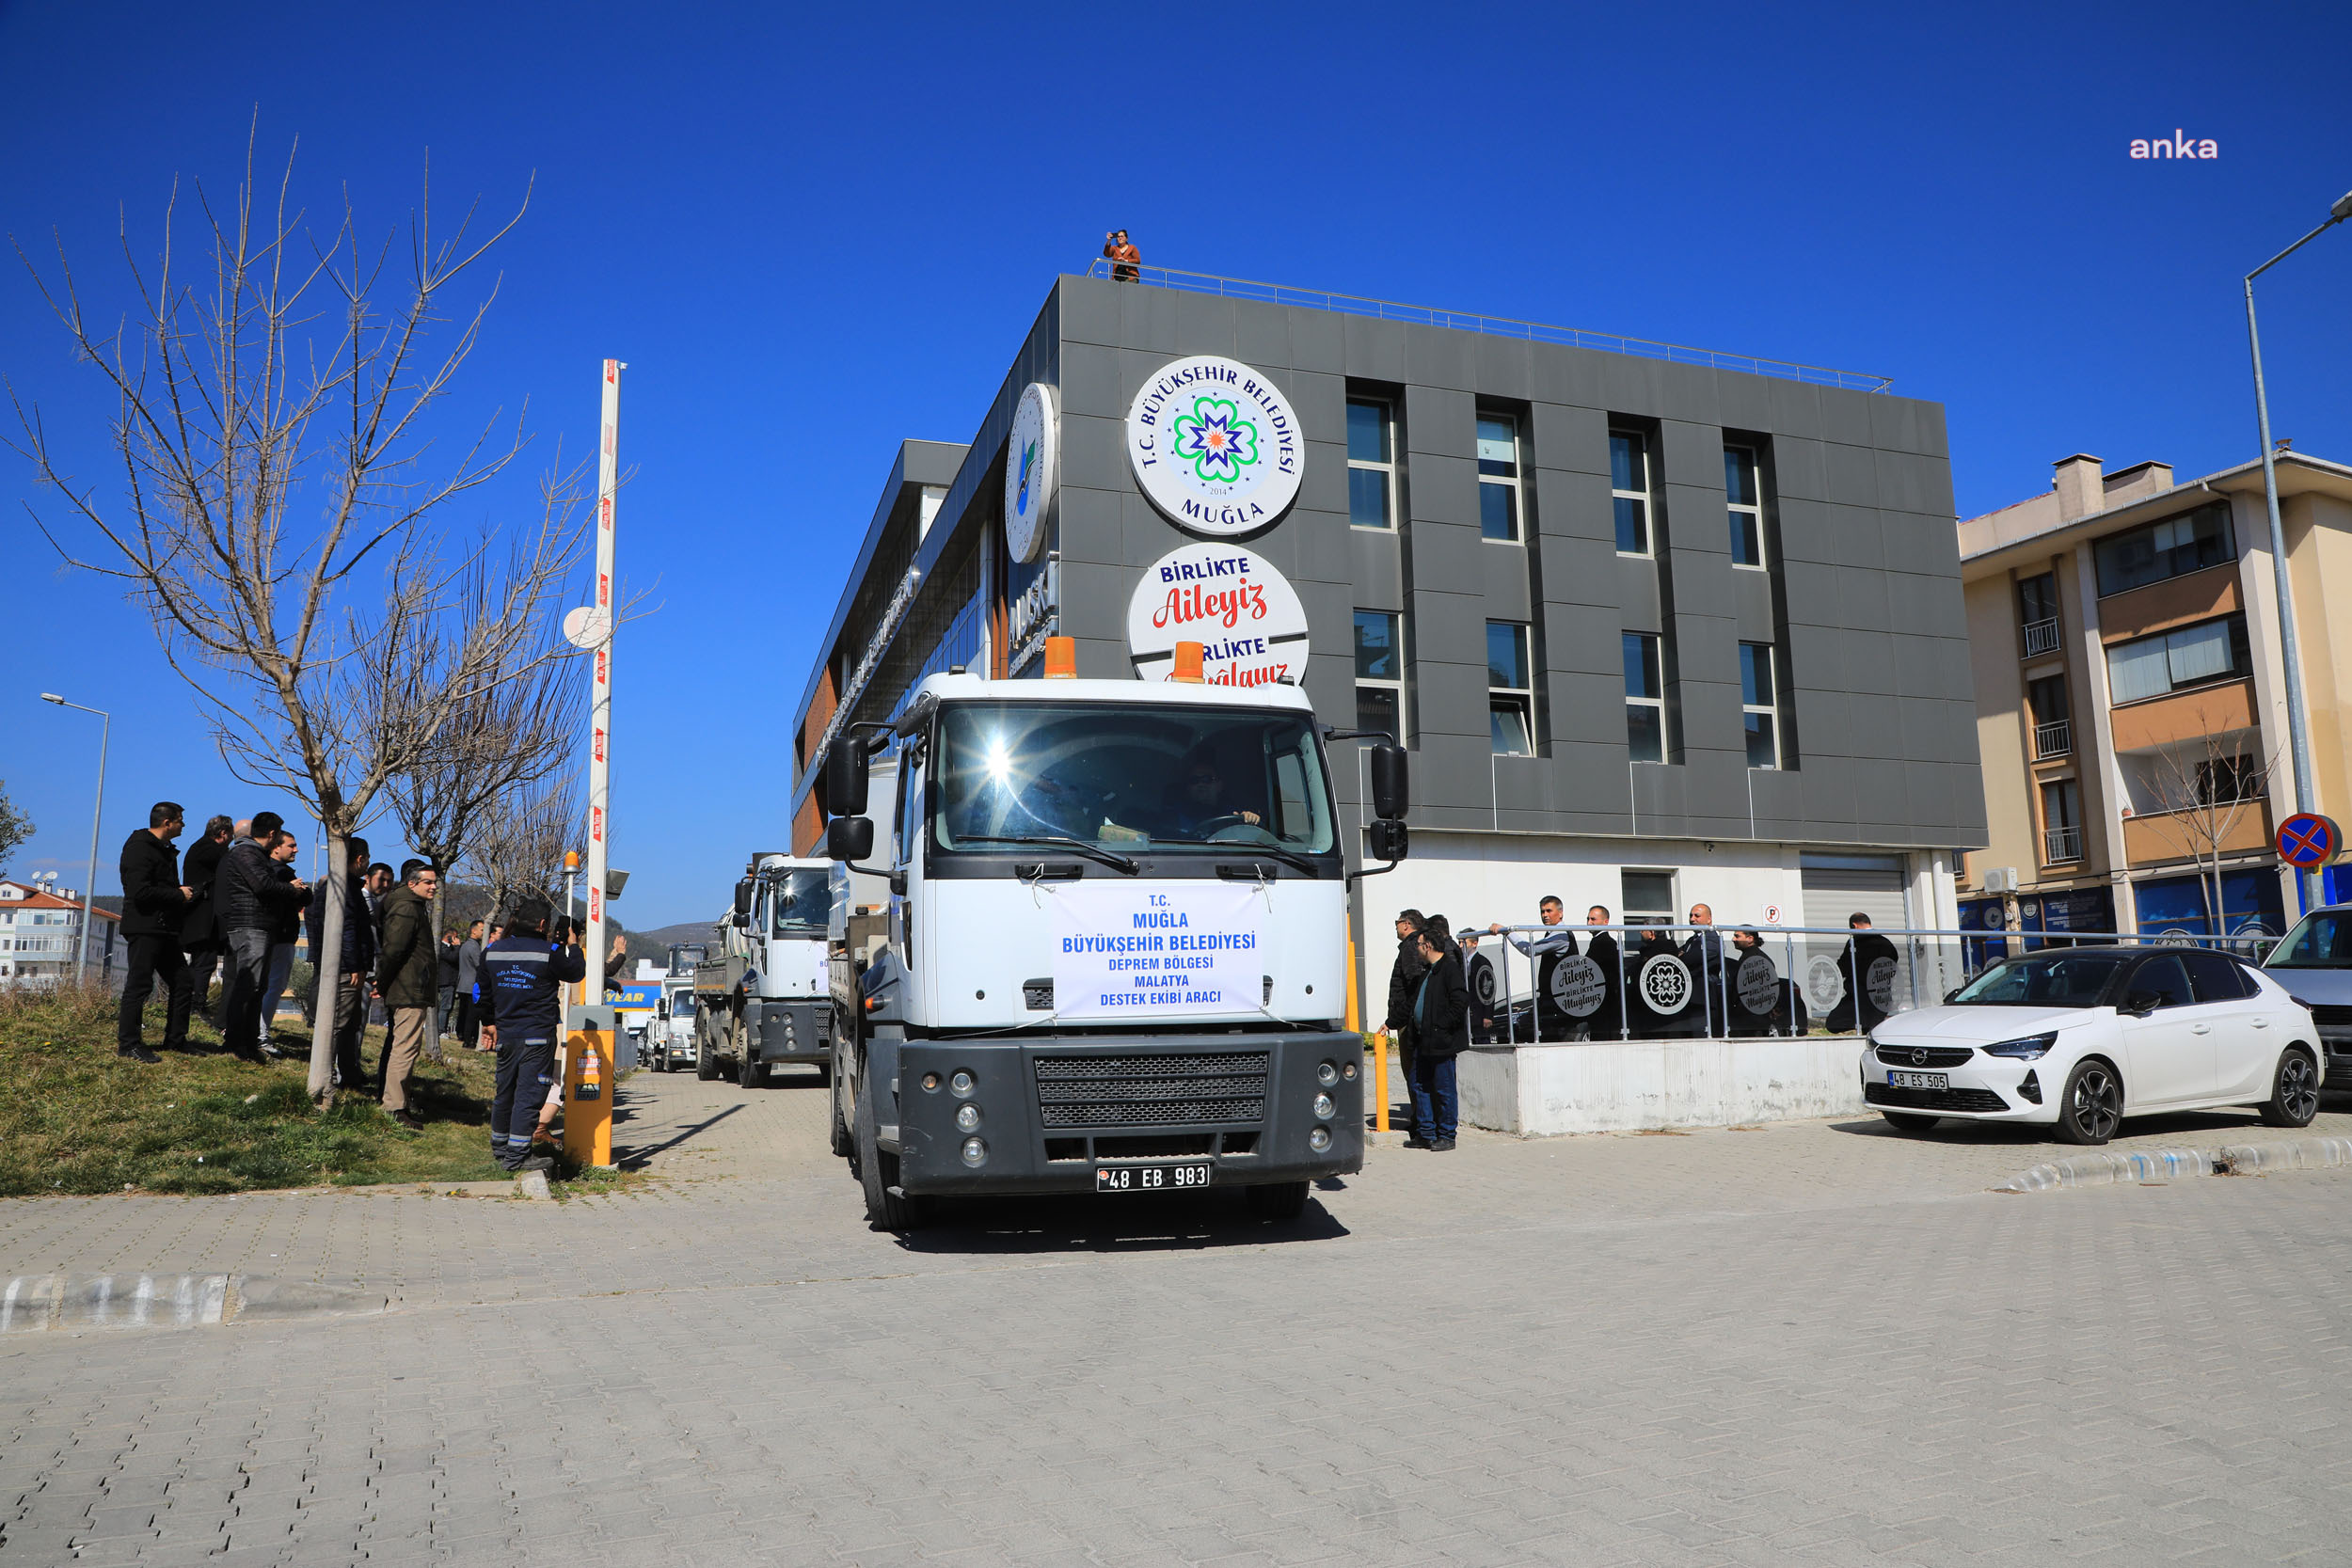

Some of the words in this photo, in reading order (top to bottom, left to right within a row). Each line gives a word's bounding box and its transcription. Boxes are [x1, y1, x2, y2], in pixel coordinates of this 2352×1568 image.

[1140, 364, 1238, 426] BÜYÜKŞEHİR
[1242, 379, 1295, 475] BELEDİYESİ
[1139, 434, 1157, 469] T.C.
[1210, 487, 1227, 496] 2014
[1181, 499, 1264, 525] MUĞLA
[1160, 556, 1250, 583] BİRLİKTE
[1152, 578, 1268, 628] Aileyiz
[1203, 638, 1265, 662] RLİKTE
[1149, 895, 1171, 907] T.C.
[1133, 909, 1188, 928] MUĞLA
[1062, 932, 1164, 956] BÜYÜKŞEHİR
[1169, 930, 1256, 950] BELEDİYESİ
[1108, 958, 1159, 972] DEPREM
[1164, 954, 1214, 970] BÖLGESİ
[1560, 958, 1588, 970] BİRLİKTE
[1135, 974, 1189, 988] MALATYA
[1559, 966, 1595, 987] Aileyiz
[1100, 993, 1146, 1006] DESTEK
[1150, 990, 1182, 1005] EKİBİ
[1185, 990, 1221, 1004] ARACI
[1566, 985, 1594, 997] BİRLİKTE
[1563, 993, 1601, 1010] Muğlayız
[1894, 1073, 1905, 1085] 48
[1911, 1074, 1923, 1086] ES
[1927, 1076, 1946, 1088] 505
[1109, 1170, 1130, 1188] 48
[1142, 1169, 1163, 1187] EB
[1175, 1167, 1206, 1185] 983
